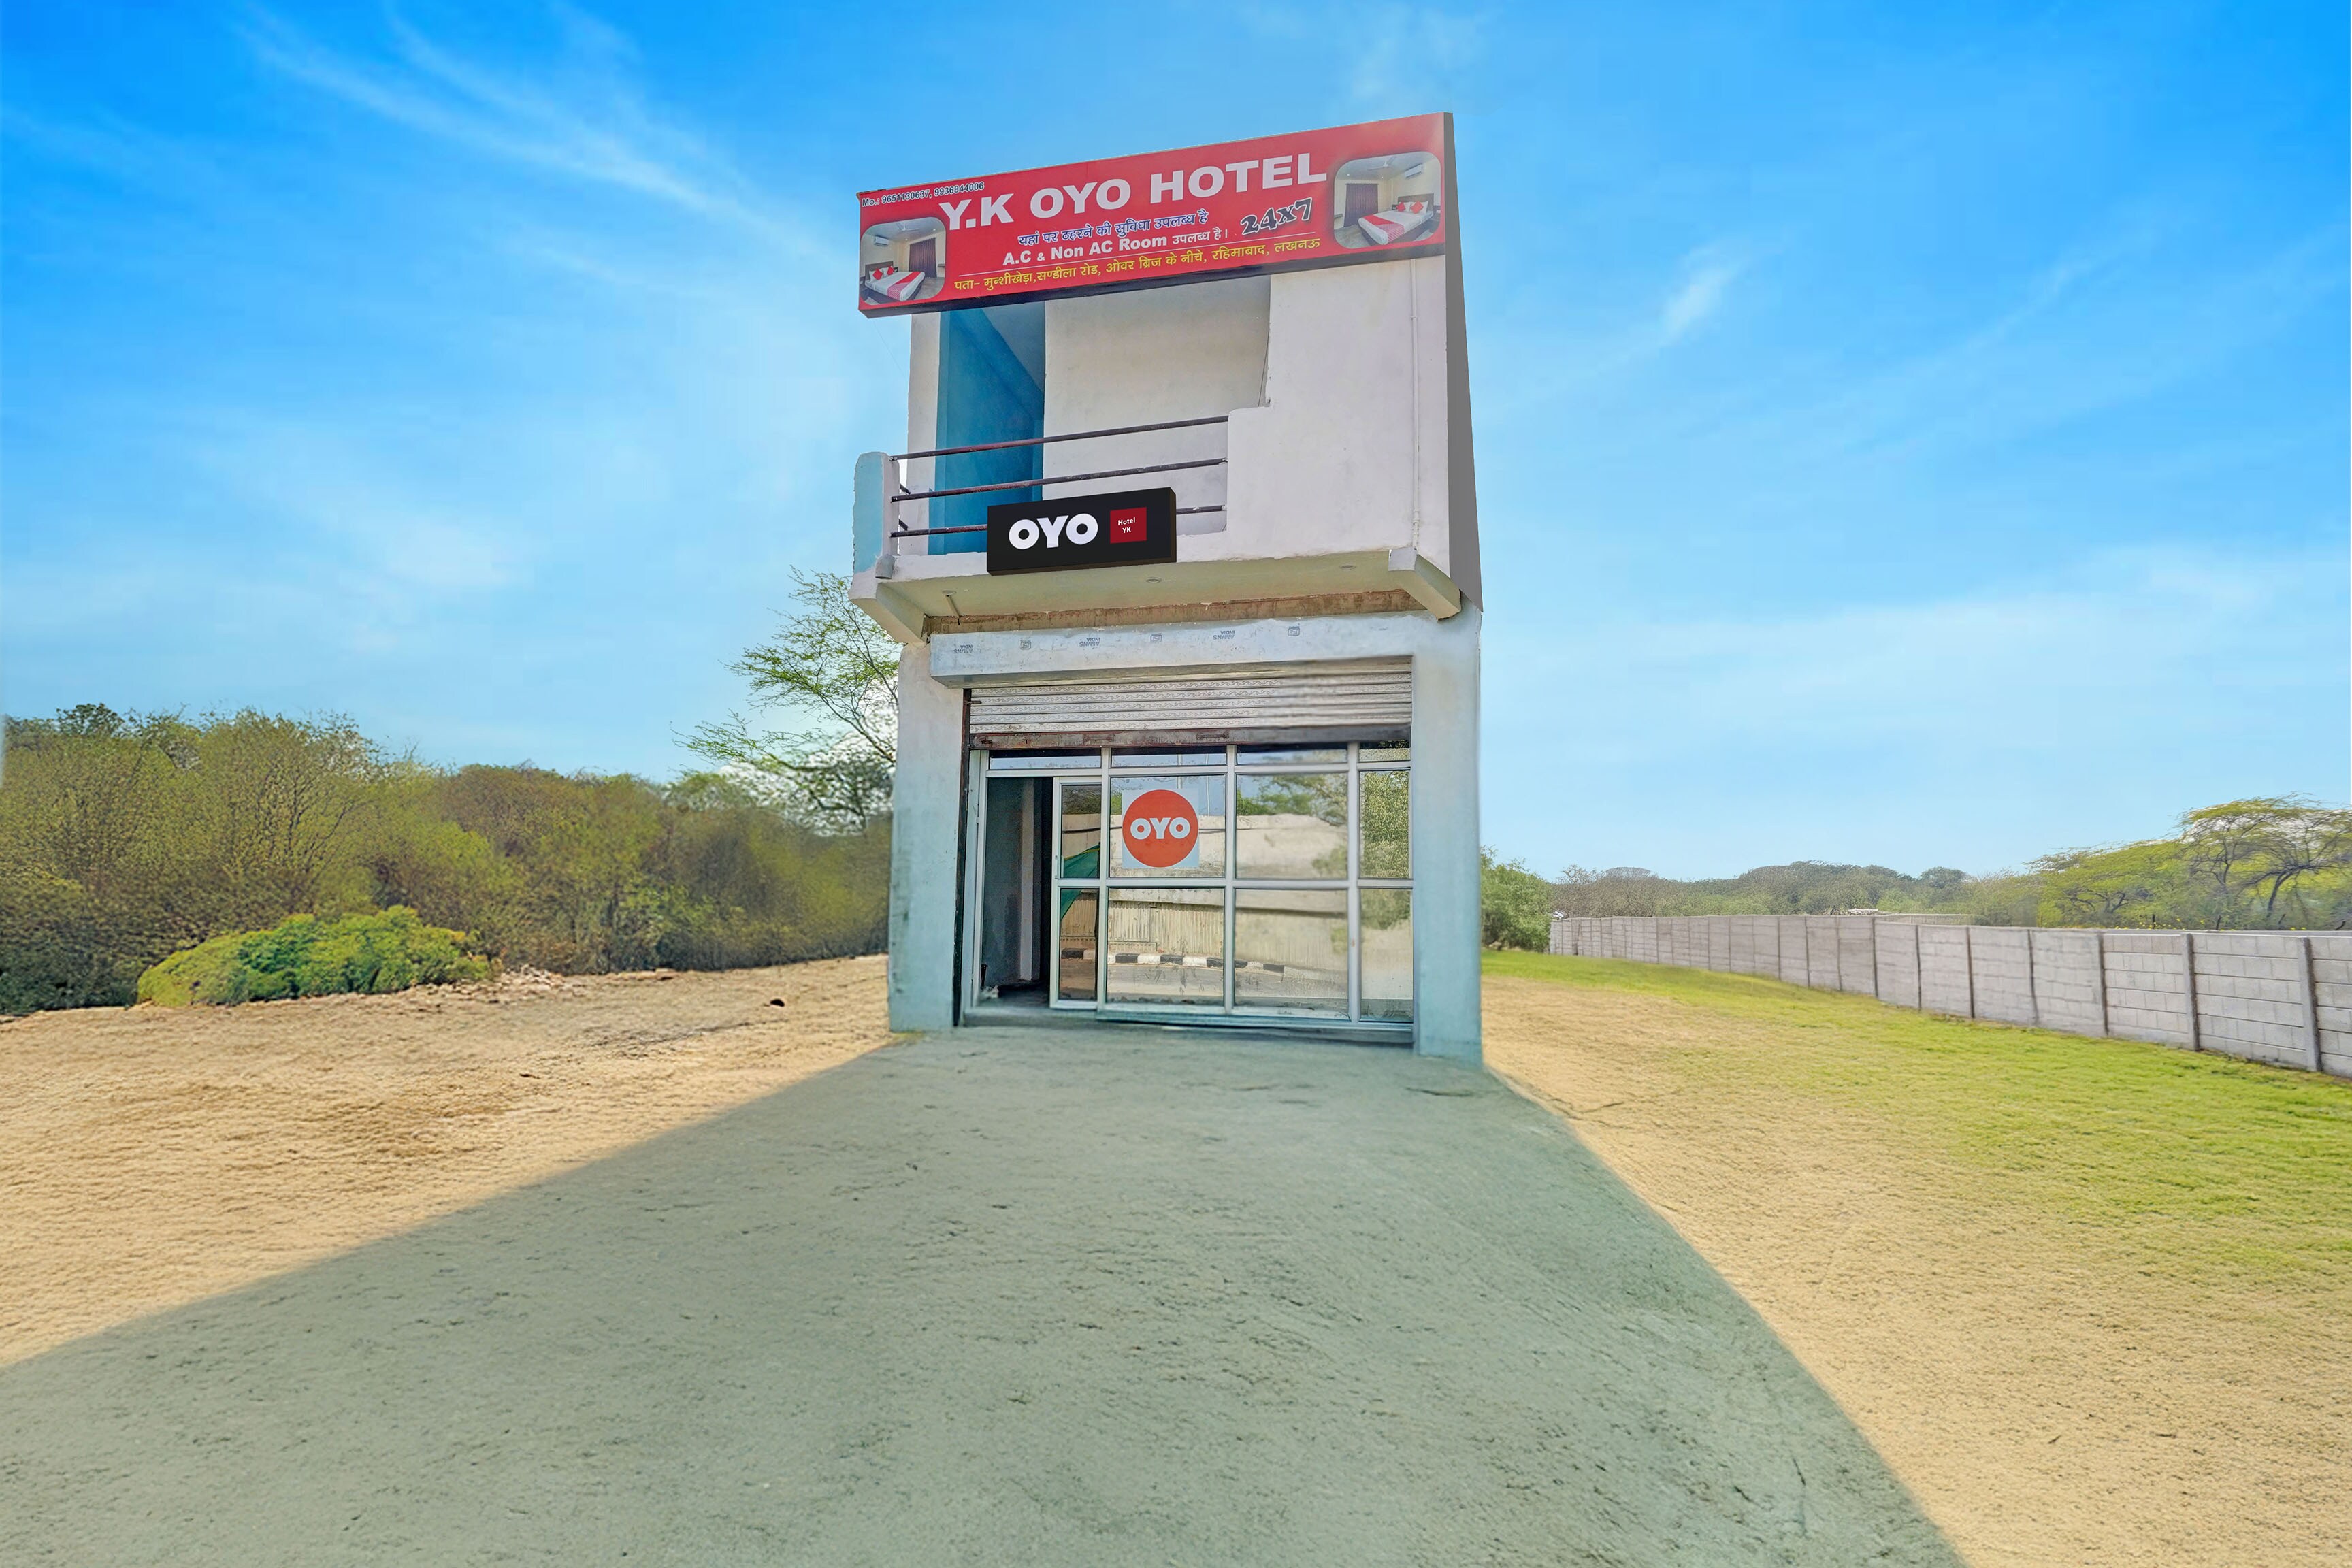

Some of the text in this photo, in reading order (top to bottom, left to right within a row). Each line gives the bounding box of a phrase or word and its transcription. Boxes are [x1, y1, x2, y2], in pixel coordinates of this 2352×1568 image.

[862, 197, 880, 207] Mo.:
[934, 182, 985, 197] 9936844006
[938, 152, 1327, 231] Y.K OYO HOTEL
[1018, 208, 1209, 246] यहां पर ठहरने की सुविधा उपलब्ध है
[1240, 197, 1313, 236] 24x7
[1002, 250, 1032, 266] A.C
[1036, 252, 1045, 262] &
[1051, 245, 1083, 260] Non
[1089, 240, 1113, 255] AC
[1119, 235, 1167, 251] Room
[1172, 231, 1210, 245] उपलब्ध
[1079, 263, 1102, 276] रोड,
[1106, 259, 1135, 272] ओवर
[1139, 252, 1162, 270] ब्रिज
[1166, 252, 1178, 265] के
[1180, 249, 1207, 265] नीचे,
[1211, 244, 1270, 260] रहिमाबाद,
[1274, 238, 1322, 253] लखनऊ
[1009, 513, 1098, 550] OYO
[1117, 517, 1136, 526] Hotel
[1130, 816, 1191, 840] OYO
